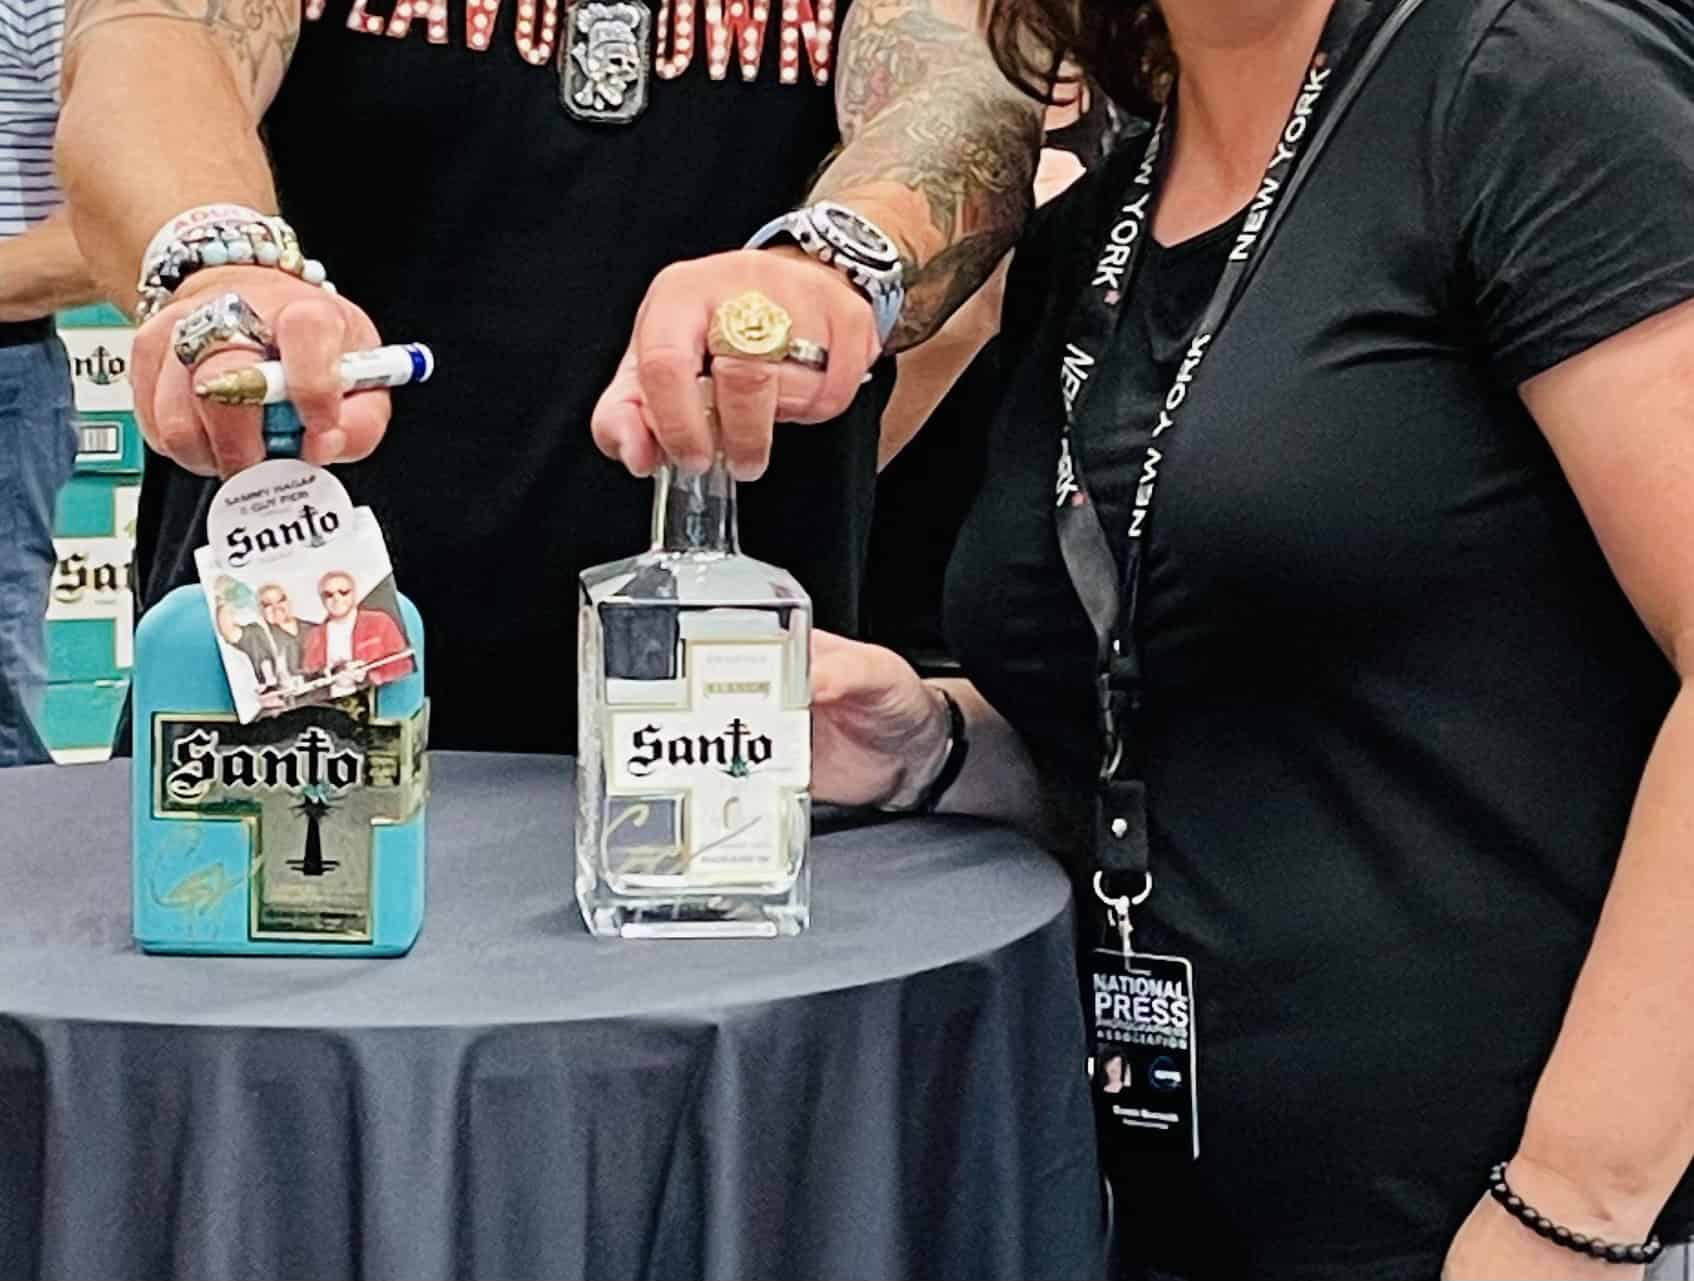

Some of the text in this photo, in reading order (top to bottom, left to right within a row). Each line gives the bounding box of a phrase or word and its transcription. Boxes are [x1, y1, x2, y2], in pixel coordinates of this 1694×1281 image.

[1228, 68, 1331, 261] NEW YORK
[1091, 192, 1150, 289] YORK
[1128, 333, 1211, 537] NEW YORK
[226, 505, 339, 568] Santo
[166, 726, 365, 803] Santo
[627, 718, 773, 779] Santo
[1093, 972, 1188, 1003] NATIONAL
[1095, 991, 1189, 1028] PRESS
